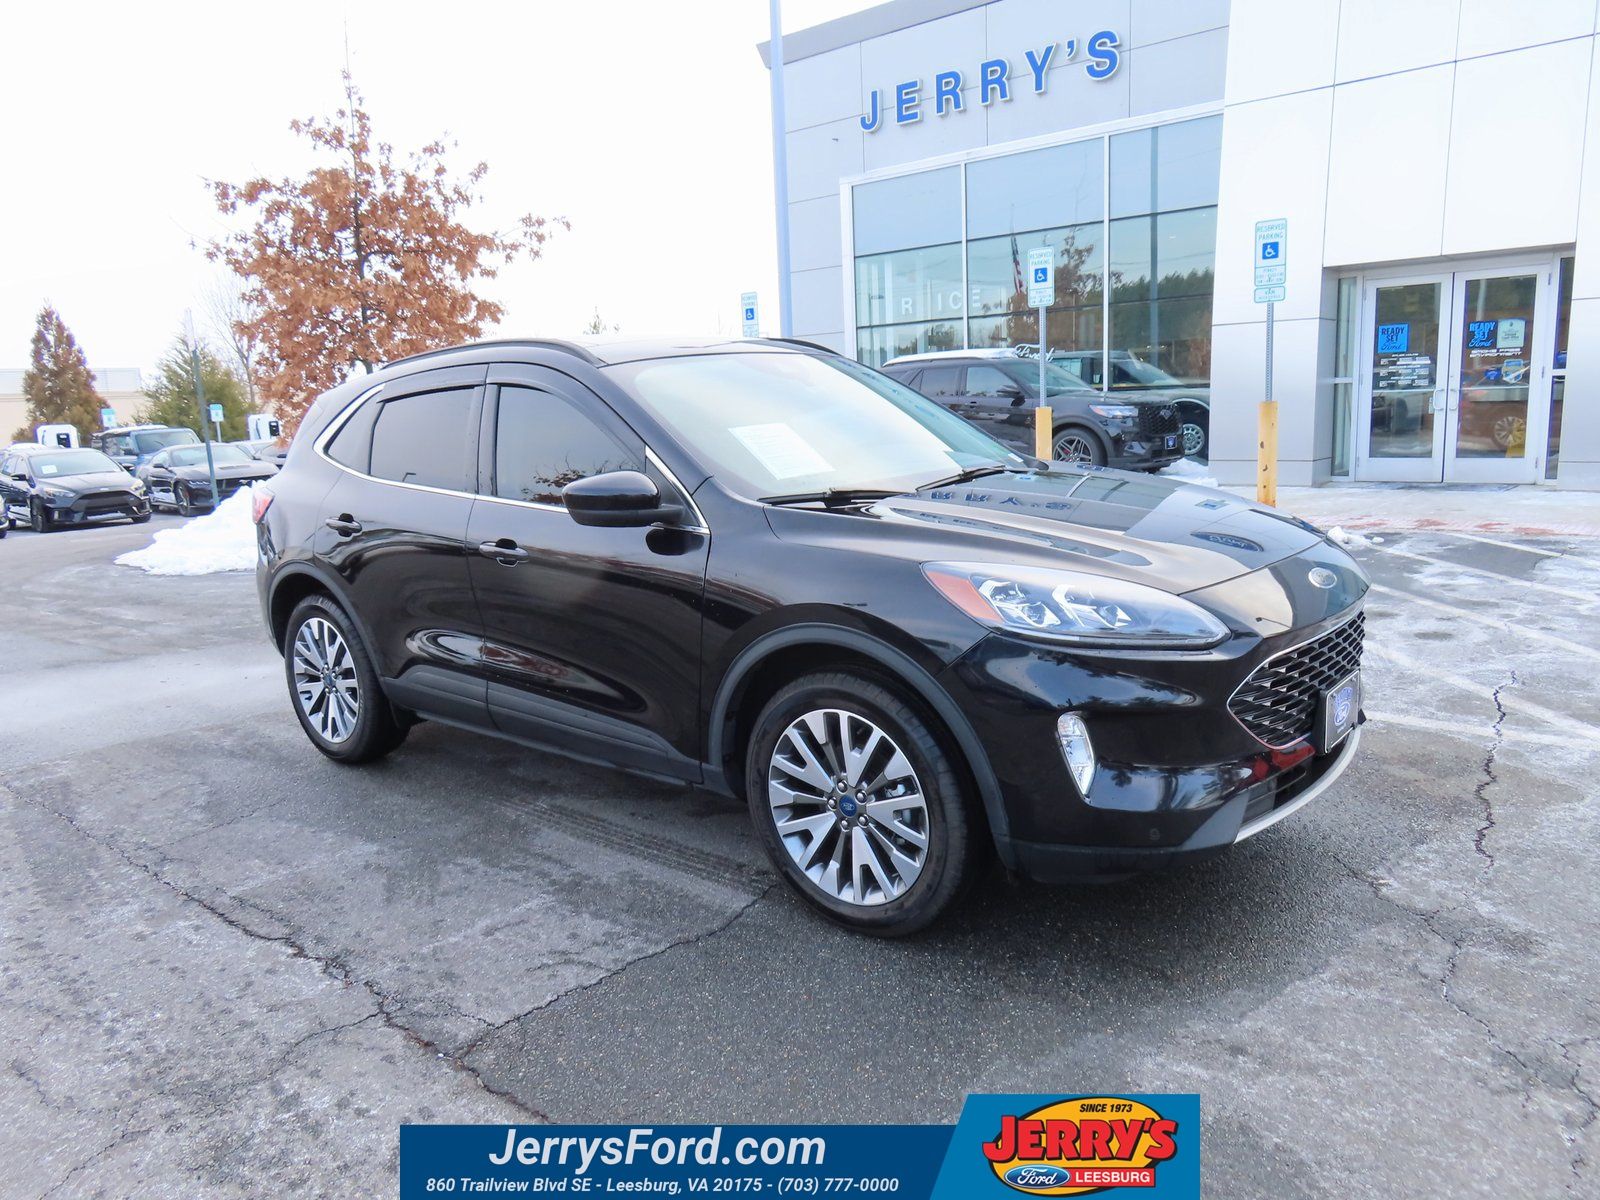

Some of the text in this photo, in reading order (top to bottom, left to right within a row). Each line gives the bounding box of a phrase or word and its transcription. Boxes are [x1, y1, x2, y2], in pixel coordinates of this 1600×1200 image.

[859, 29, 1121, 132] JERRY'S
[1258, 232, 1283, 240] PARKING
[1381, 327, 1405, 335] READY
[1470, 322, 1495, 331] READY
[1386, 334, 1399, 342] SET
[1474, 330, 1489, 339] SET
[1468, 337, 1493, 347] Ford
